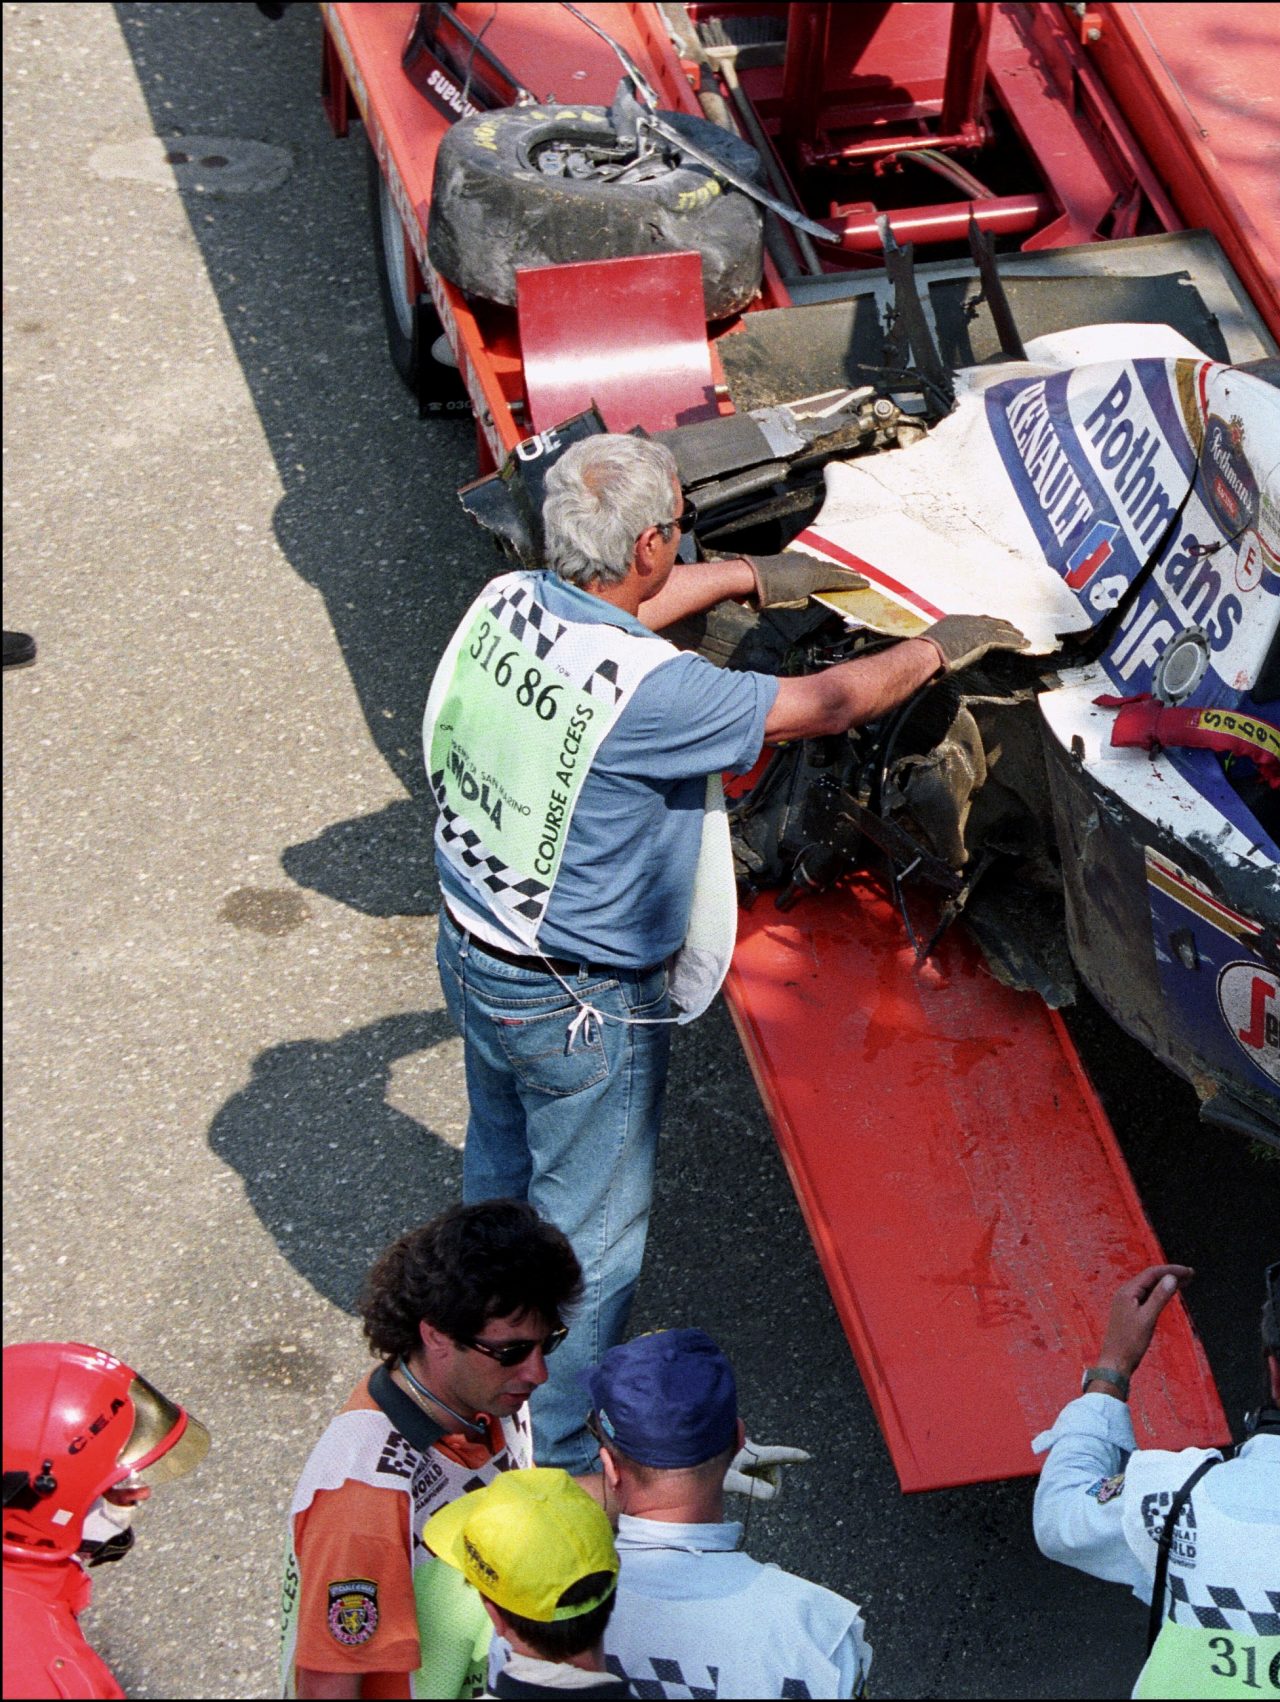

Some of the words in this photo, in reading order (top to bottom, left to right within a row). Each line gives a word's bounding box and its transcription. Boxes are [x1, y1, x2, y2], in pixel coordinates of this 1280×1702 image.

[1006, 380, 1094, 547] RENAULT
[1084, 370, 1243, 652] Rothmans
[1089, 574, 1176, 681] elf
[534, 789, 568, 875] COURSE
[555, 704, 594, 789] ACCESS
